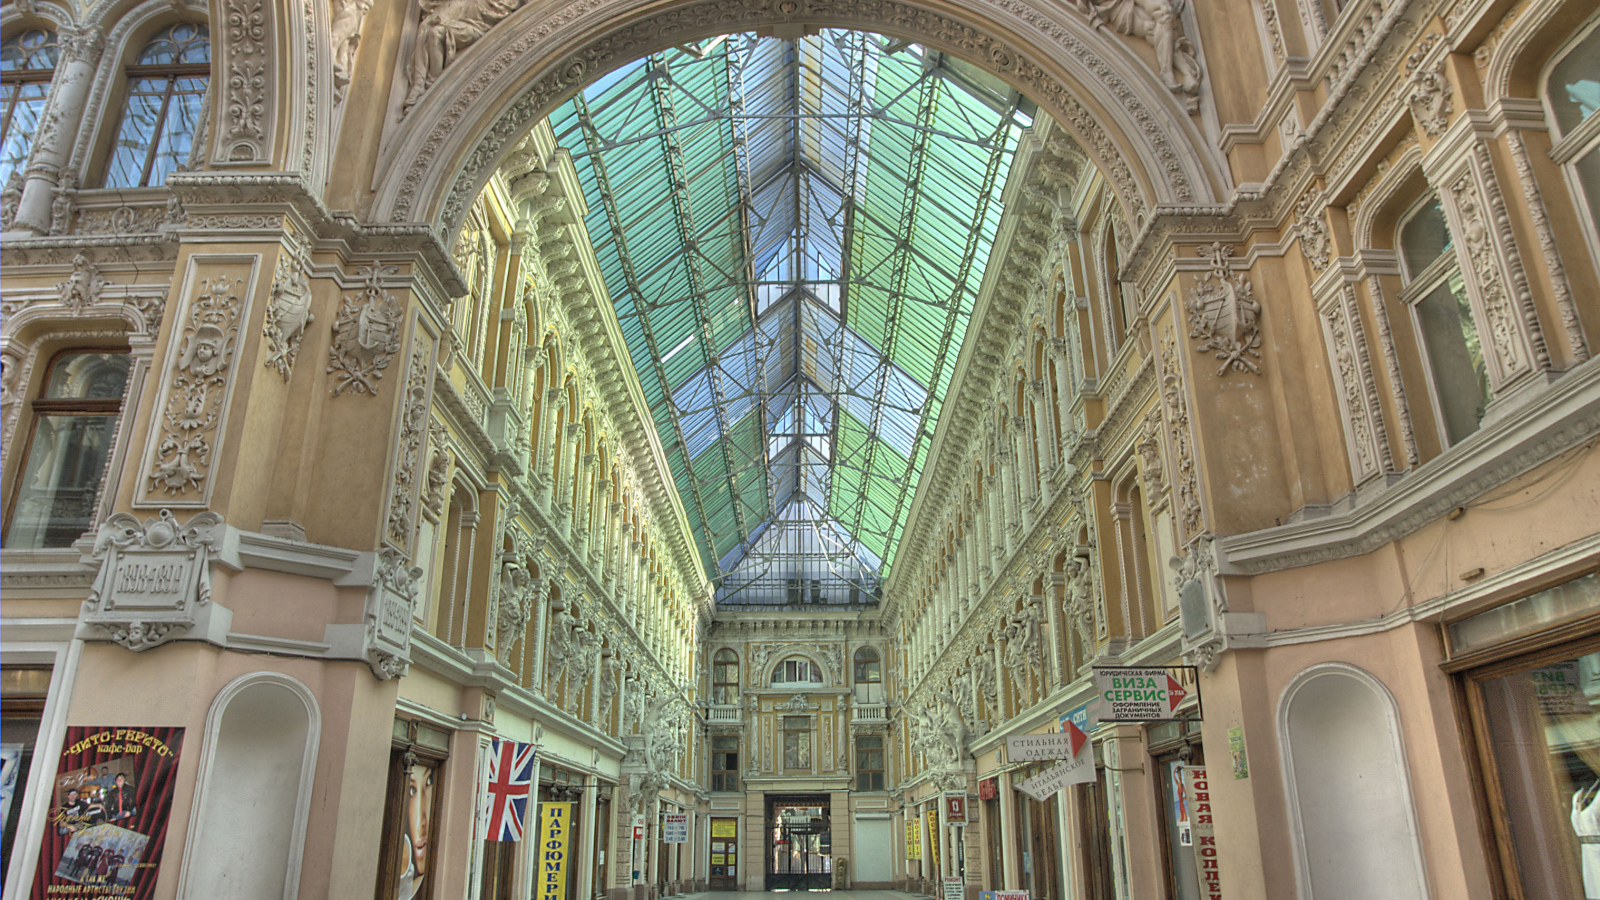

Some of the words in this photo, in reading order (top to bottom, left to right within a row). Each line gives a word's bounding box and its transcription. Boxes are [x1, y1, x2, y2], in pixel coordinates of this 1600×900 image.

[1112, 678, 1157, 689] ВИЗА
[1104, 690, 1166, 701] СЕРВИС
[1013, 738, 1069, 748] СТИЛЬНАЯ
[1026, 748, 1070, 757] ОДЕЖДА
[1031, 759, 1086, 790] ИТАЛЬЯНСКОЕ
[1035, 780, 1064, 799] БЕЛЬЕ
[1192, 770, 1213, 824] НОВАЯ
